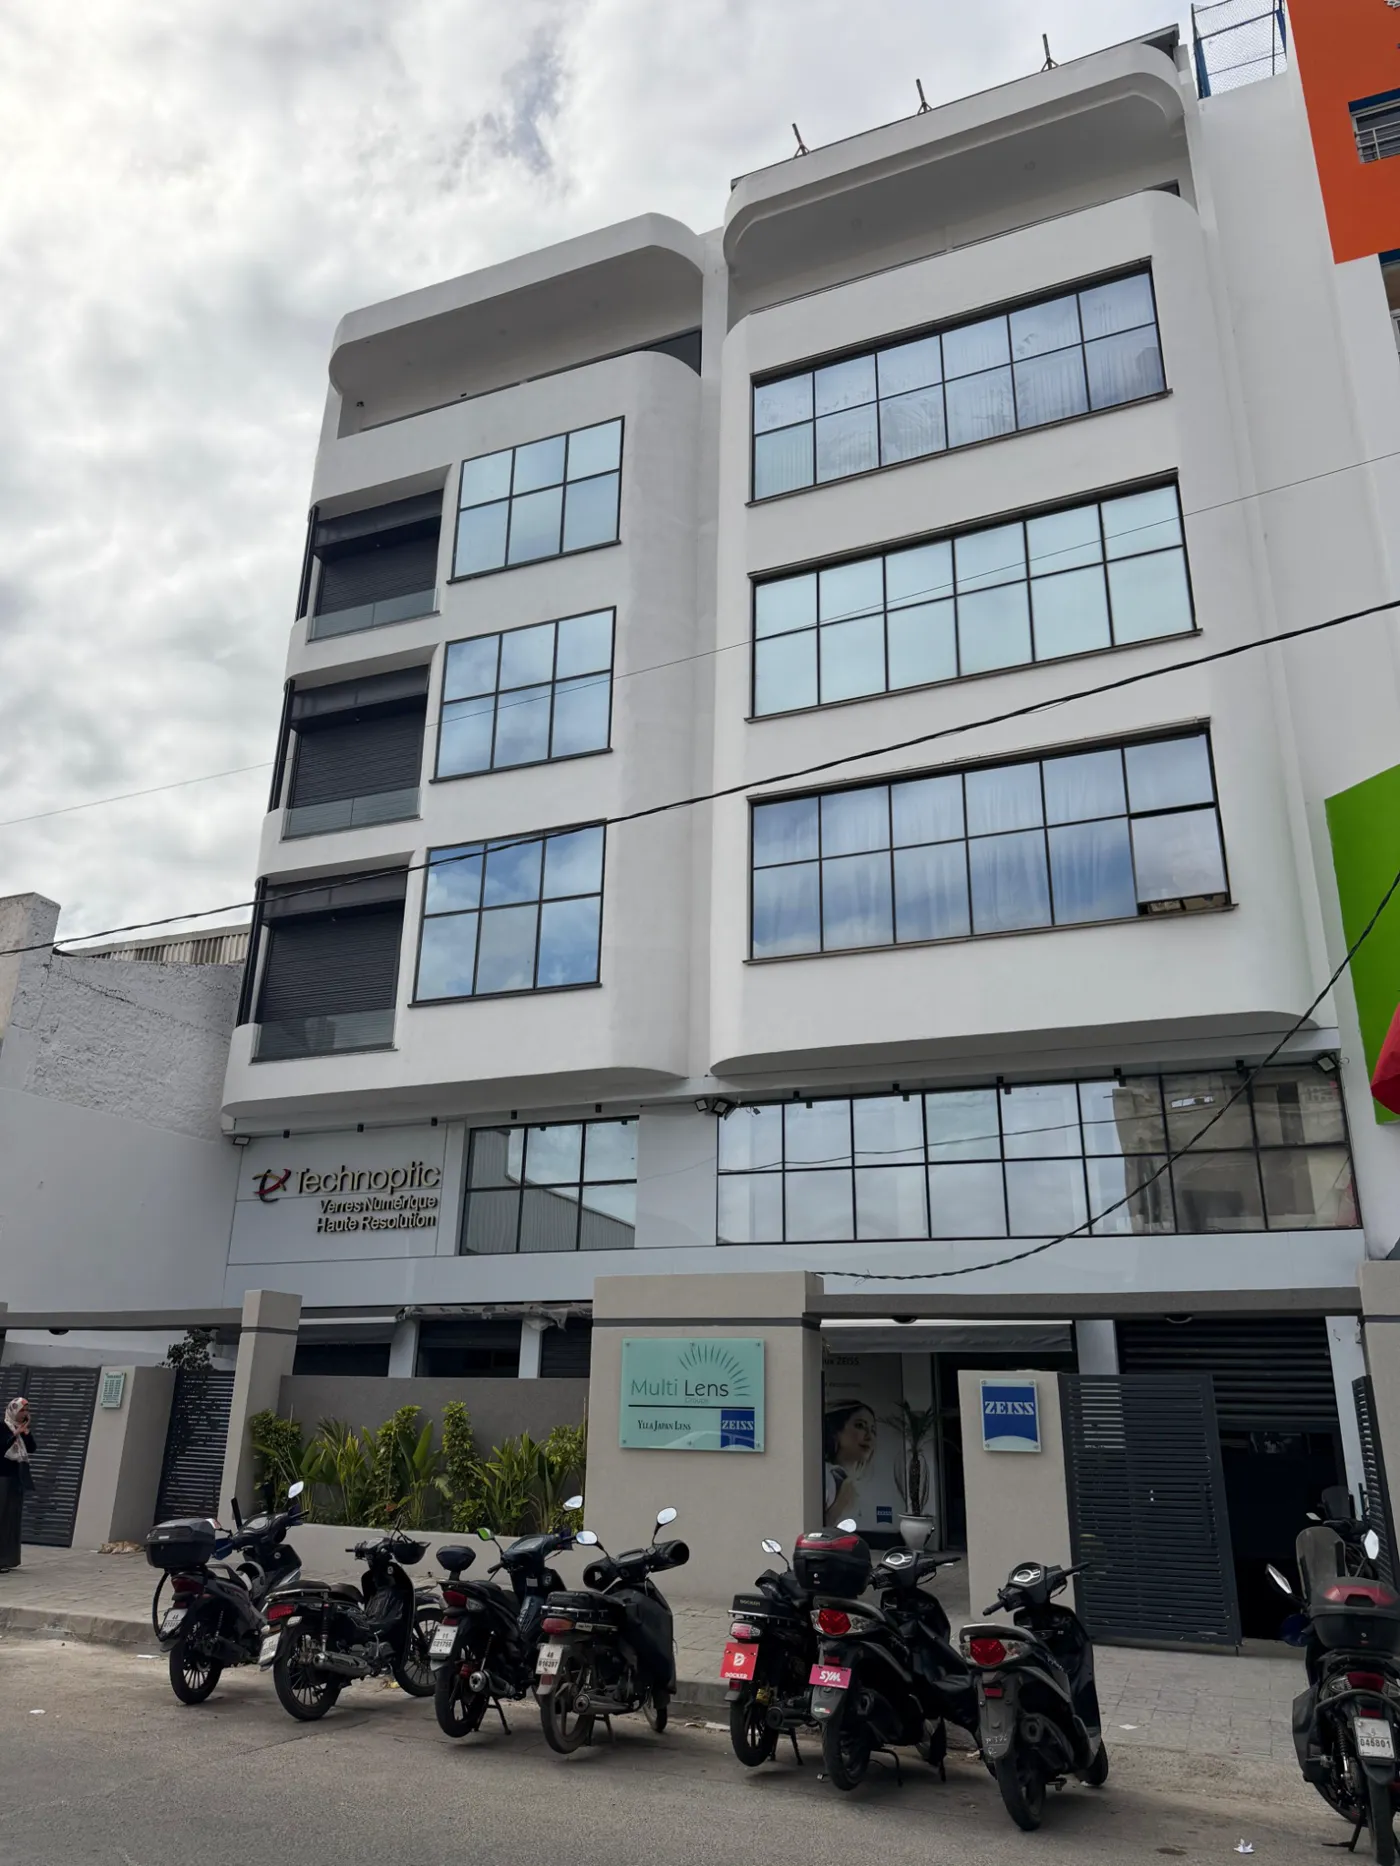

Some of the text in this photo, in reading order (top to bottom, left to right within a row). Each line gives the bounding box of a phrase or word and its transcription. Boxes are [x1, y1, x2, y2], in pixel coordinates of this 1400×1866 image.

[296, 1160, 441, 1195] Technoptic
[320, 1194, 438, 1214] Verres Numérique
[316, 1211, 436, 1234] Haute Resolution
[836, 1356, 860, 1366] ZEISS
[631, 1378, 729, 1397] Multi Lens
[984, 1401, 1035, 1416] ZEISS
[674, 1420, 691, 1431] LENS
[721, 1419, 755, 1431] ZEISS
[725, 1672, 748, 1680] DOCKER
[819, 1670, 841, 1683] SYM
